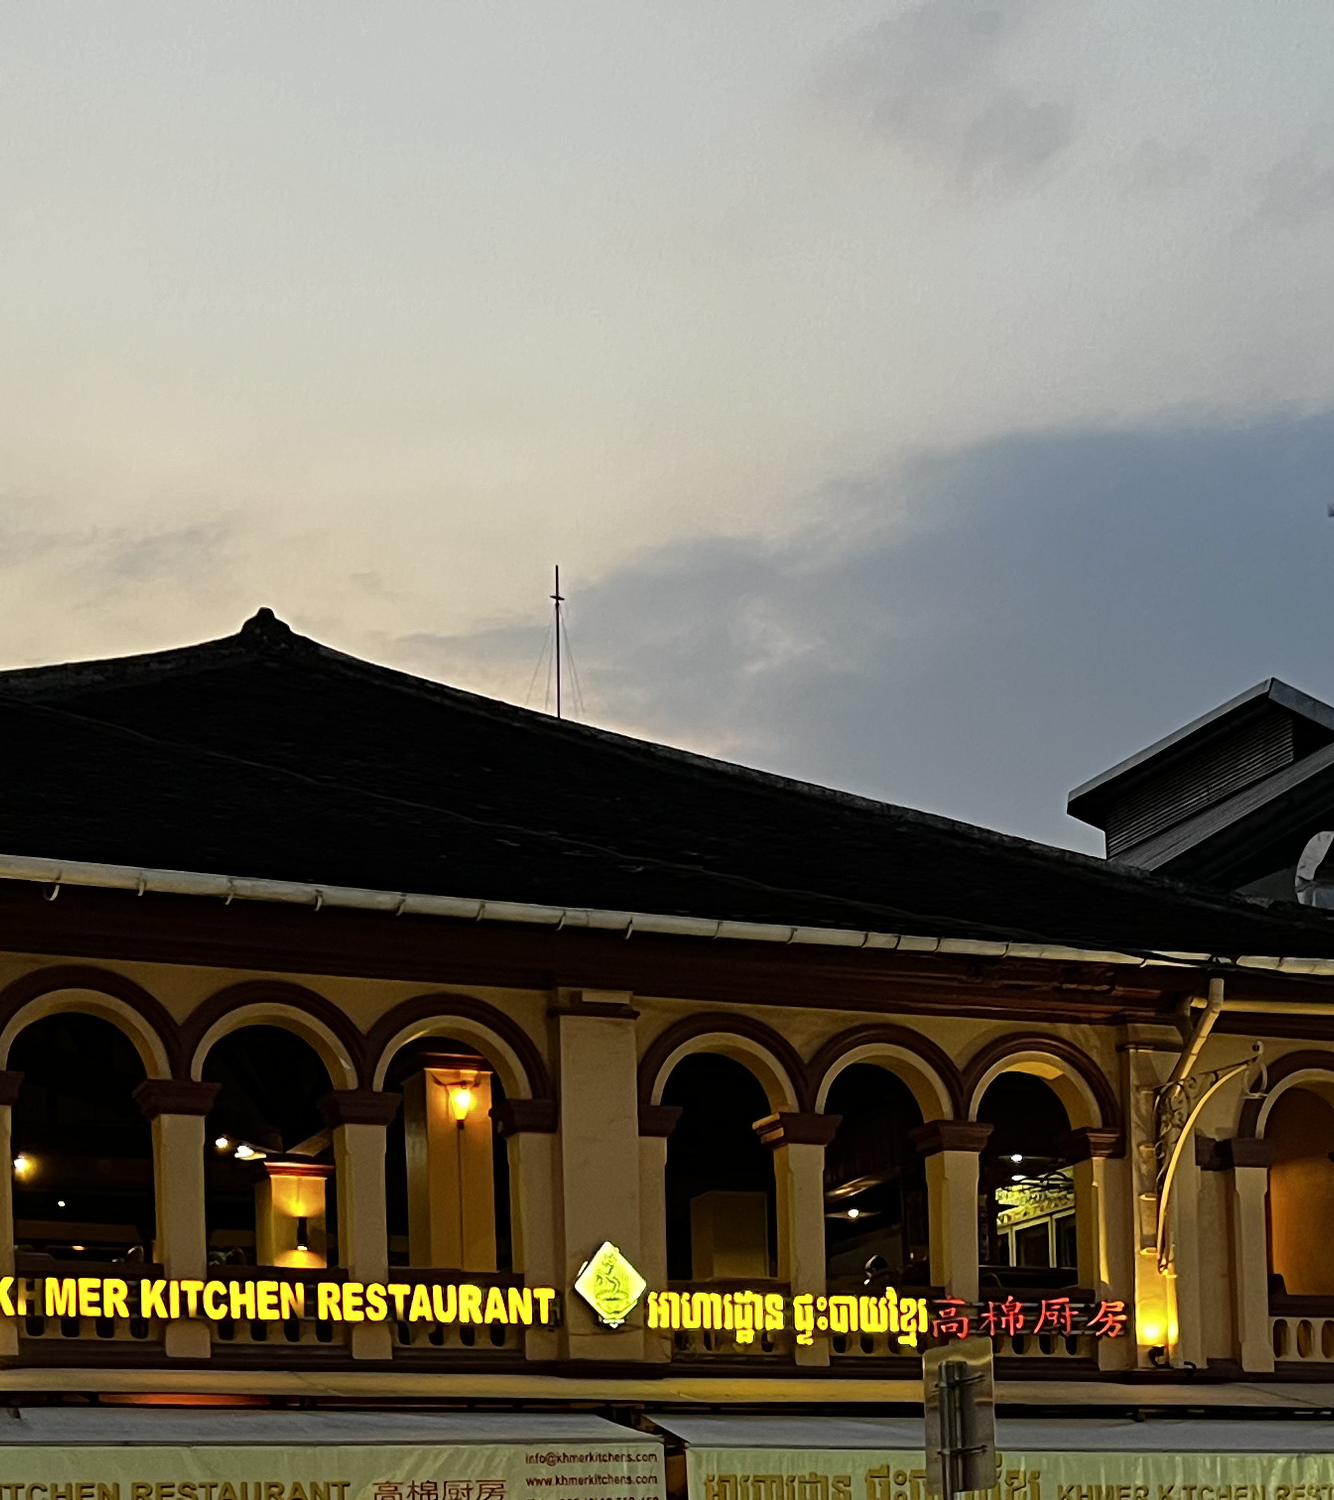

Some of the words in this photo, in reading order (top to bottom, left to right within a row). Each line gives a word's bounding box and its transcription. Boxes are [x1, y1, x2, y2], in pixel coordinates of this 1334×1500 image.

[141, 1277, 305, 1320] KITCHEN
[317, 1281, 556, 1325] RESTAURANT
[931, 1296, 1128, 1339] 高棉厨房
[525, 1451, 657, 1466] info@khmerkitchens.com
[526, 1474, 658, 1486] www.khmerkitchens.com
